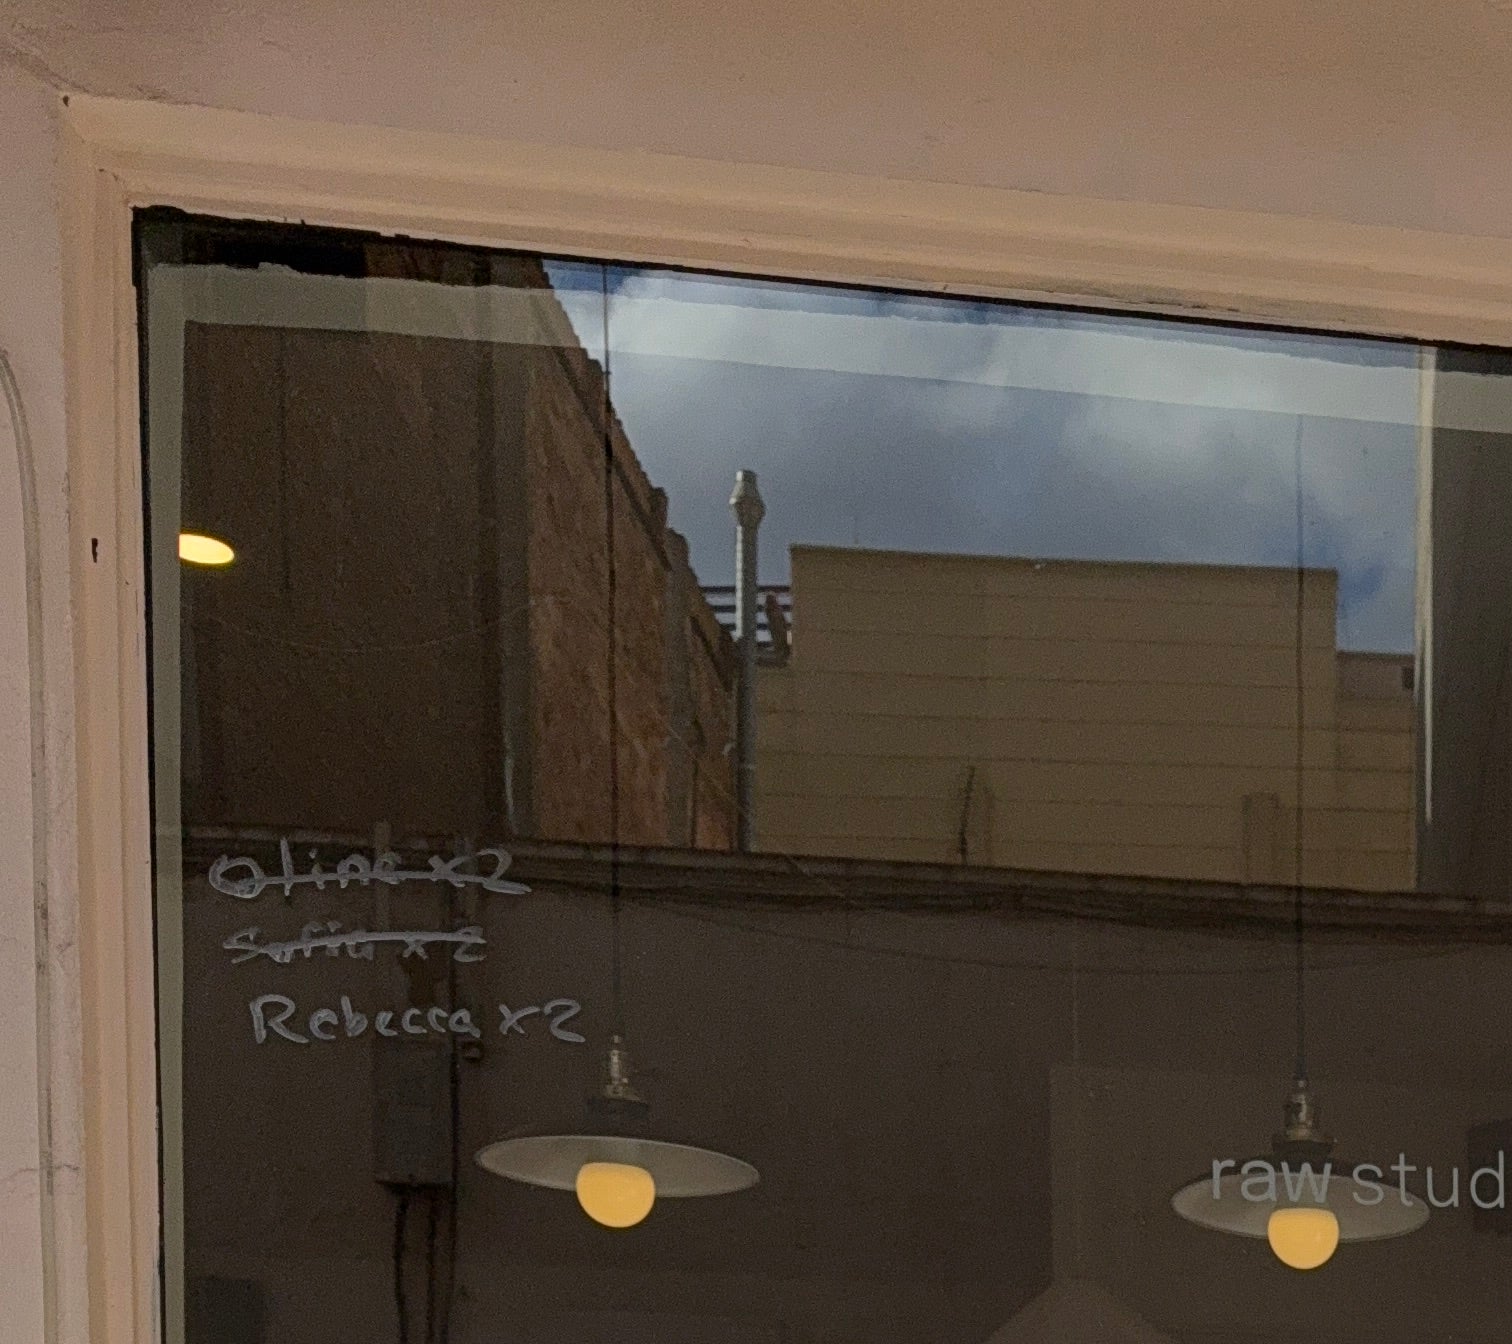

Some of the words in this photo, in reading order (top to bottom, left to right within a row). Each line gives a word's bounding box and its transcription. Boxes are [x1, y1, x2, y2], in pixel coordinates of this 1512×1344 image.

[249, 994, 481, 1044] Rebecca
[500, 998, 586, 1043] x2
[1211, 1158, 1332, 1202] raw
